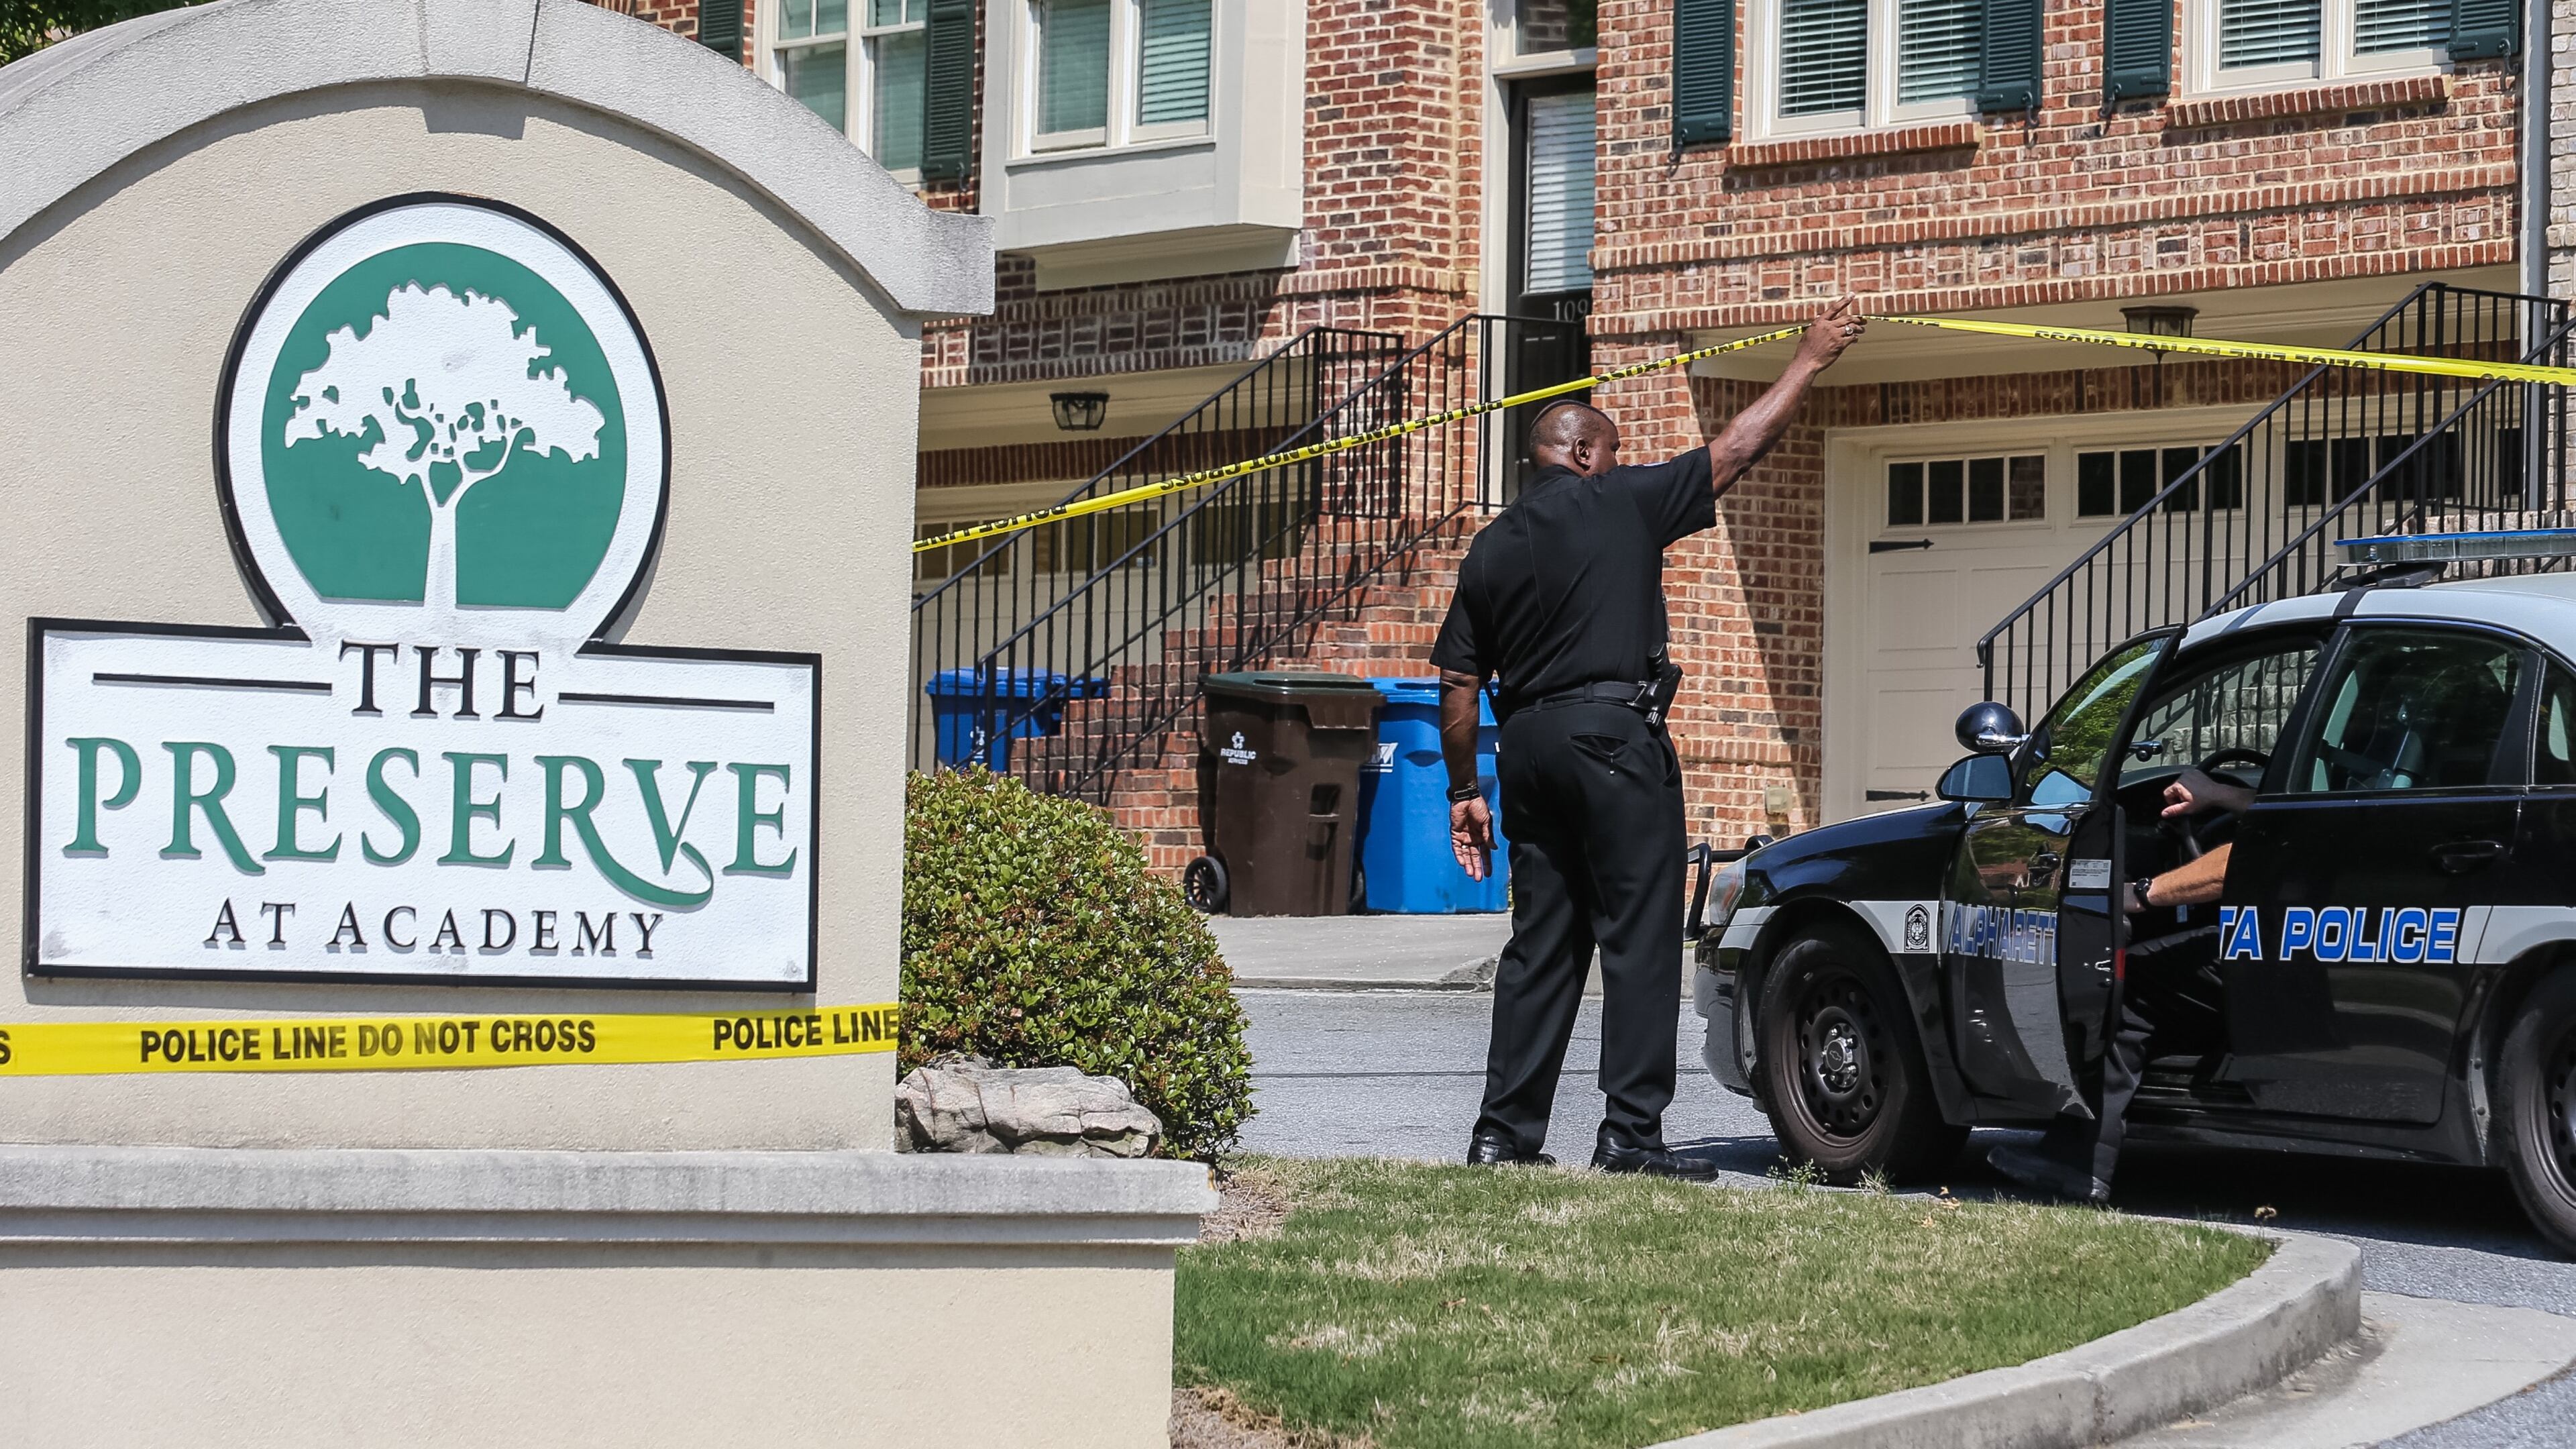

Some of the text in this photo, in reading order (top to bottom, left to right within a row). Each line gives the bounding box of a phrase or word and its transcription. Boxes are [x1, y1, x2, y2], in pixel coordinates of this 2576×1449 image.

[339, 639, 544, 721] THE
[1220, 748, 1256, 759] REPUBLIC
[62, 737, 798, 907] PRESERVE
[203, 897, 663, 957] AT ACADEMY
[2279, 906, 2461, 964] POLICE
[140, 1020, 596, 1063] POLICE LINE DO NOT CROSS
[714, 1008, 898, 1051] POLICE LINE
